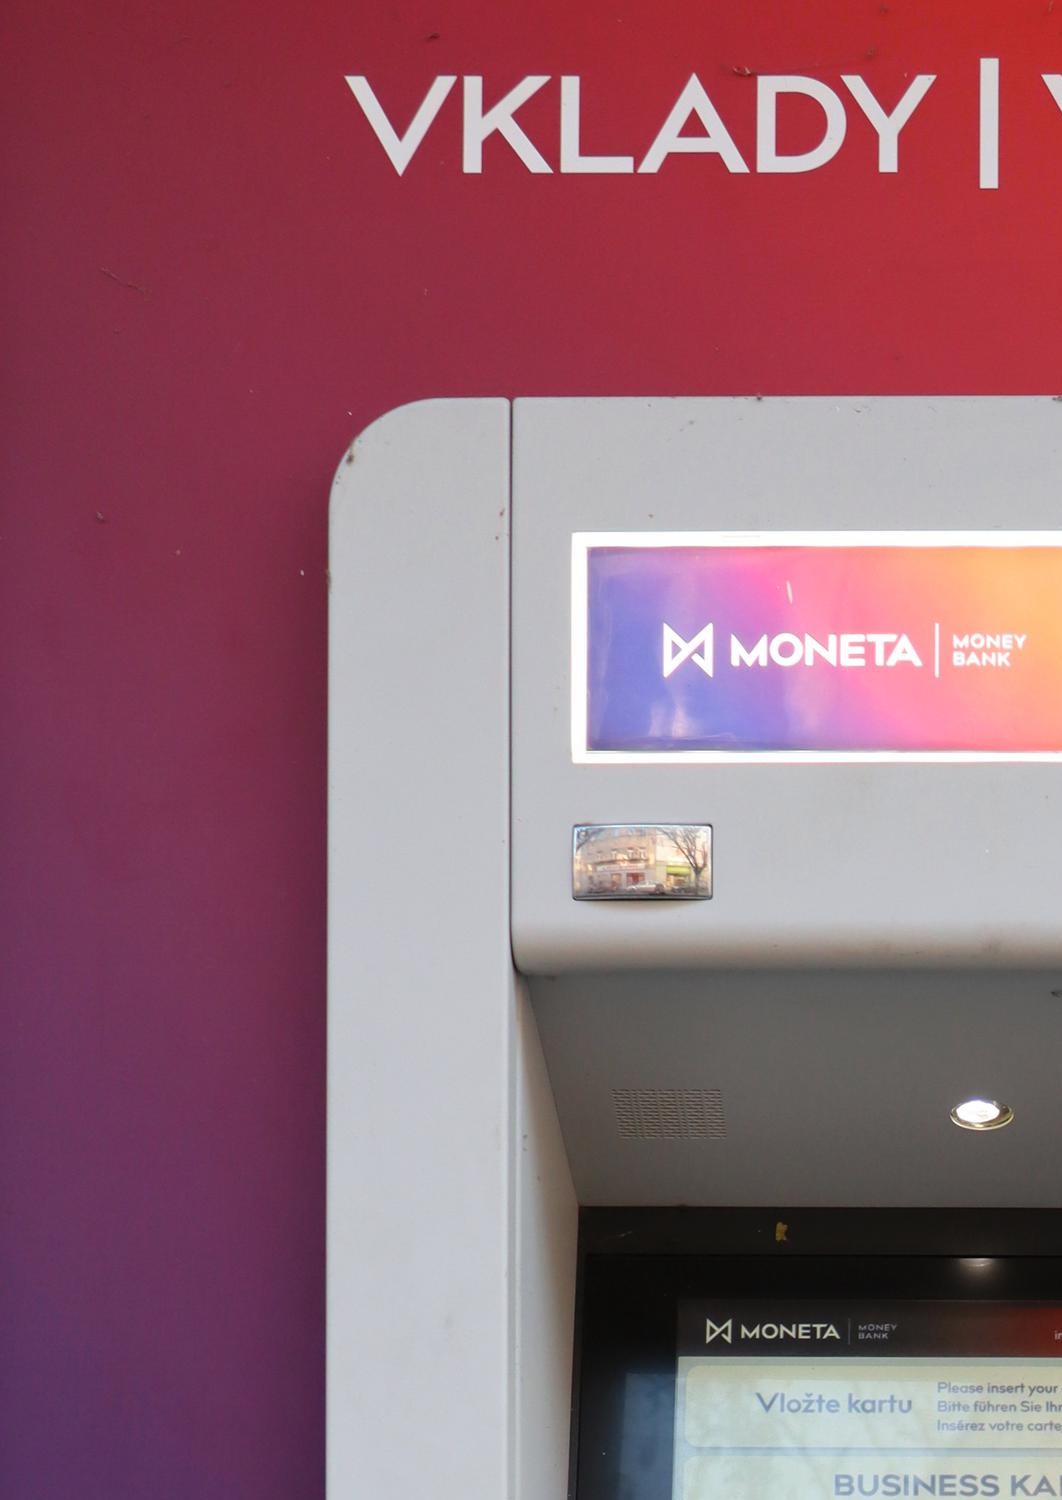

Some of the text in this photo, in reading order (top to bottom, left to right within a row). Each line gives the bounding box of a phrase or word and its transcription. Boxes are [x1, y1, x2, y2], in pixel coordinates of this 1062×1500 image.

[345, 73, 936, 176] VKLADY
[730, 633, 1027, 667] MONETA MONEY
[953, 652, 1011, 667] BANK
[740, 1323, 840, 1340] MONETA
[937, 1382, 983, 1394] Please
[987, 1382, 1025, 1394] insert
[1027, 1385, 1057, 1396] your
[756, 1392, 912, 1414] Vložte kartu
[937, 1401, 970, 1413] Bitte
[972, 1400, 1016, 1413] führen
[1020, 1401, 1041, 1413] Sie
[937, 1420, 985, 1432] Insérez
[989, 1421, 1023, 1432] votre
[834, 1474, 1000, 1496] BUSINESS
